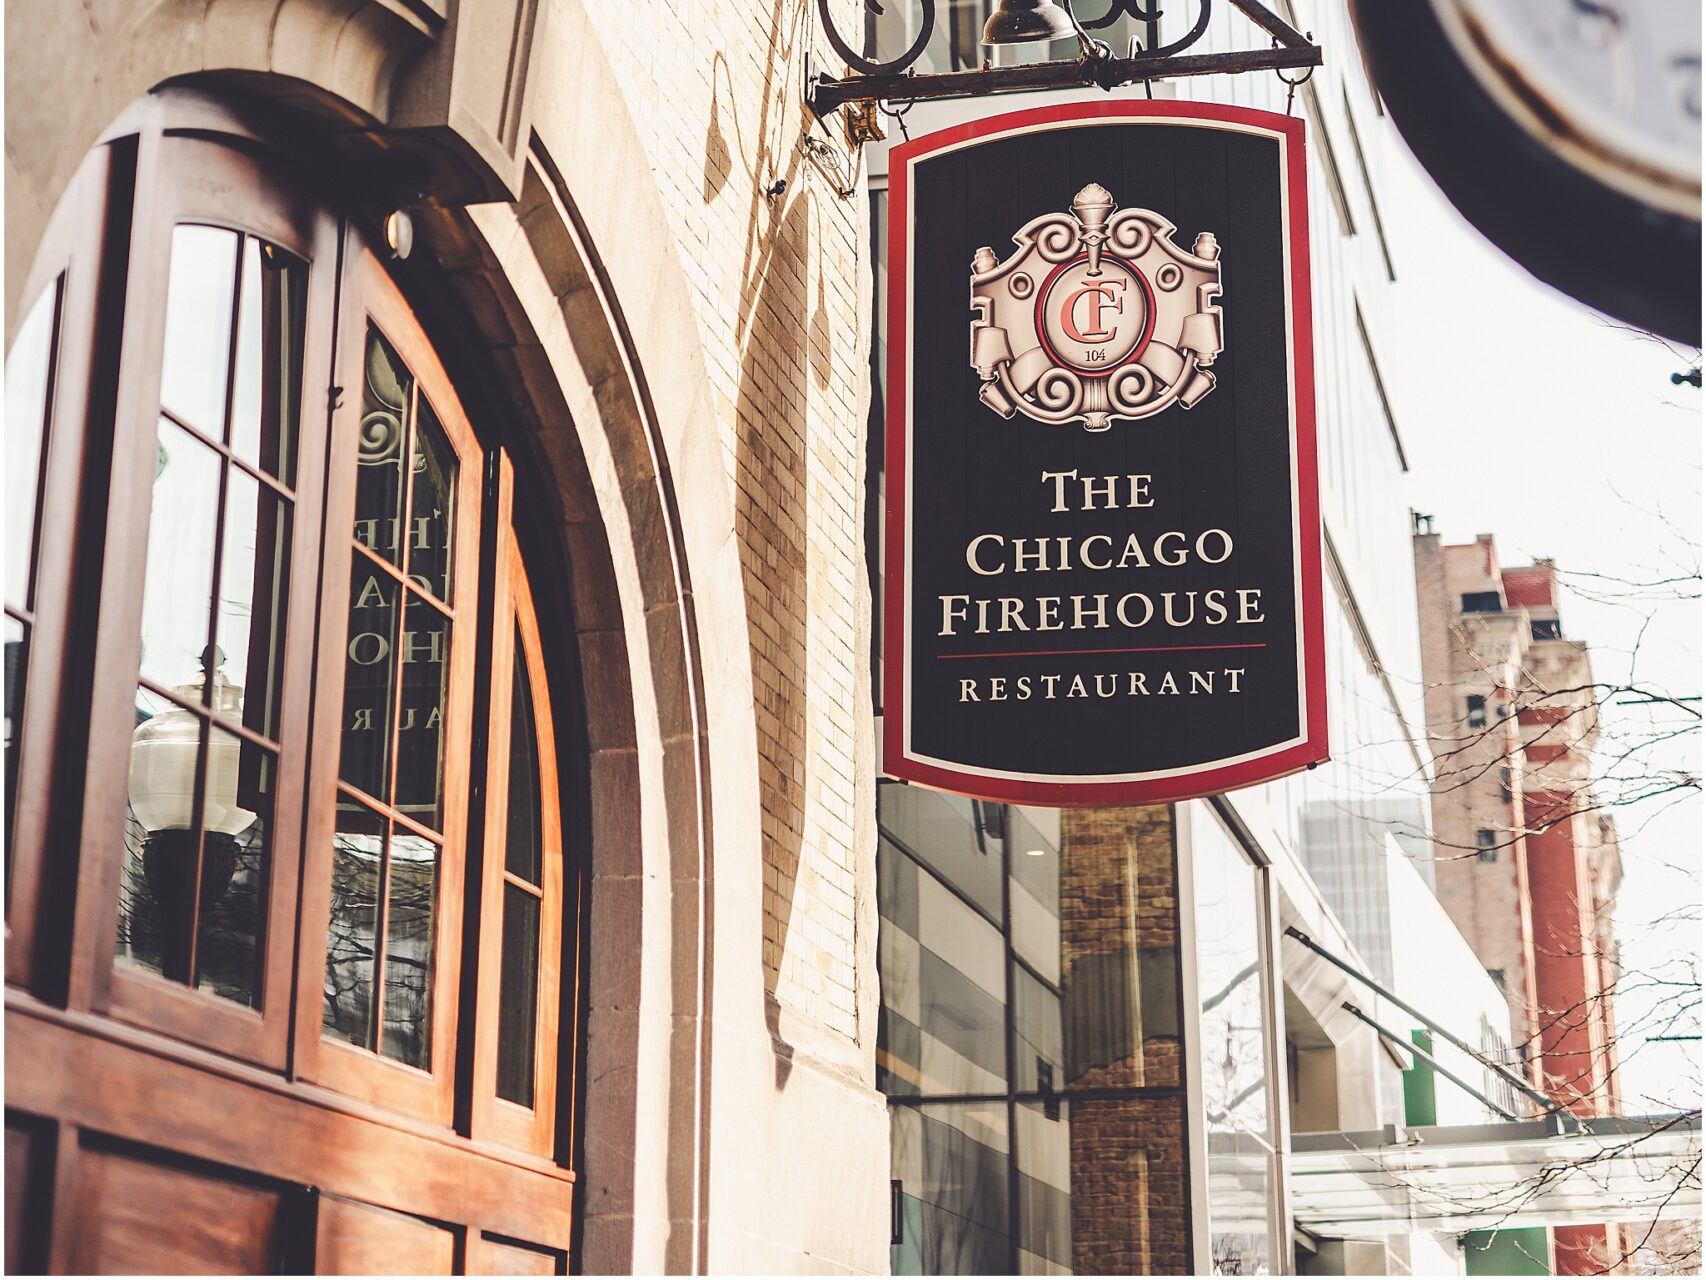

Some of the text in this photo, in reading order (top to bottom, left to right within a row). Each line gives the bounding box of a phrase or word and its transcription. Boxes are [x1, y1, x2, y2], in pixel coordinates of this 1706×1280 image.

[1085, 348, 1107, 362] 104
[1041, 468, 1155, 513] THE
[965, 528, 1234, 576] CHICAGO
[937, 588, 1265, 636] FIREHOUSE
[958, 667, 1246, 702] RESTAURANT
